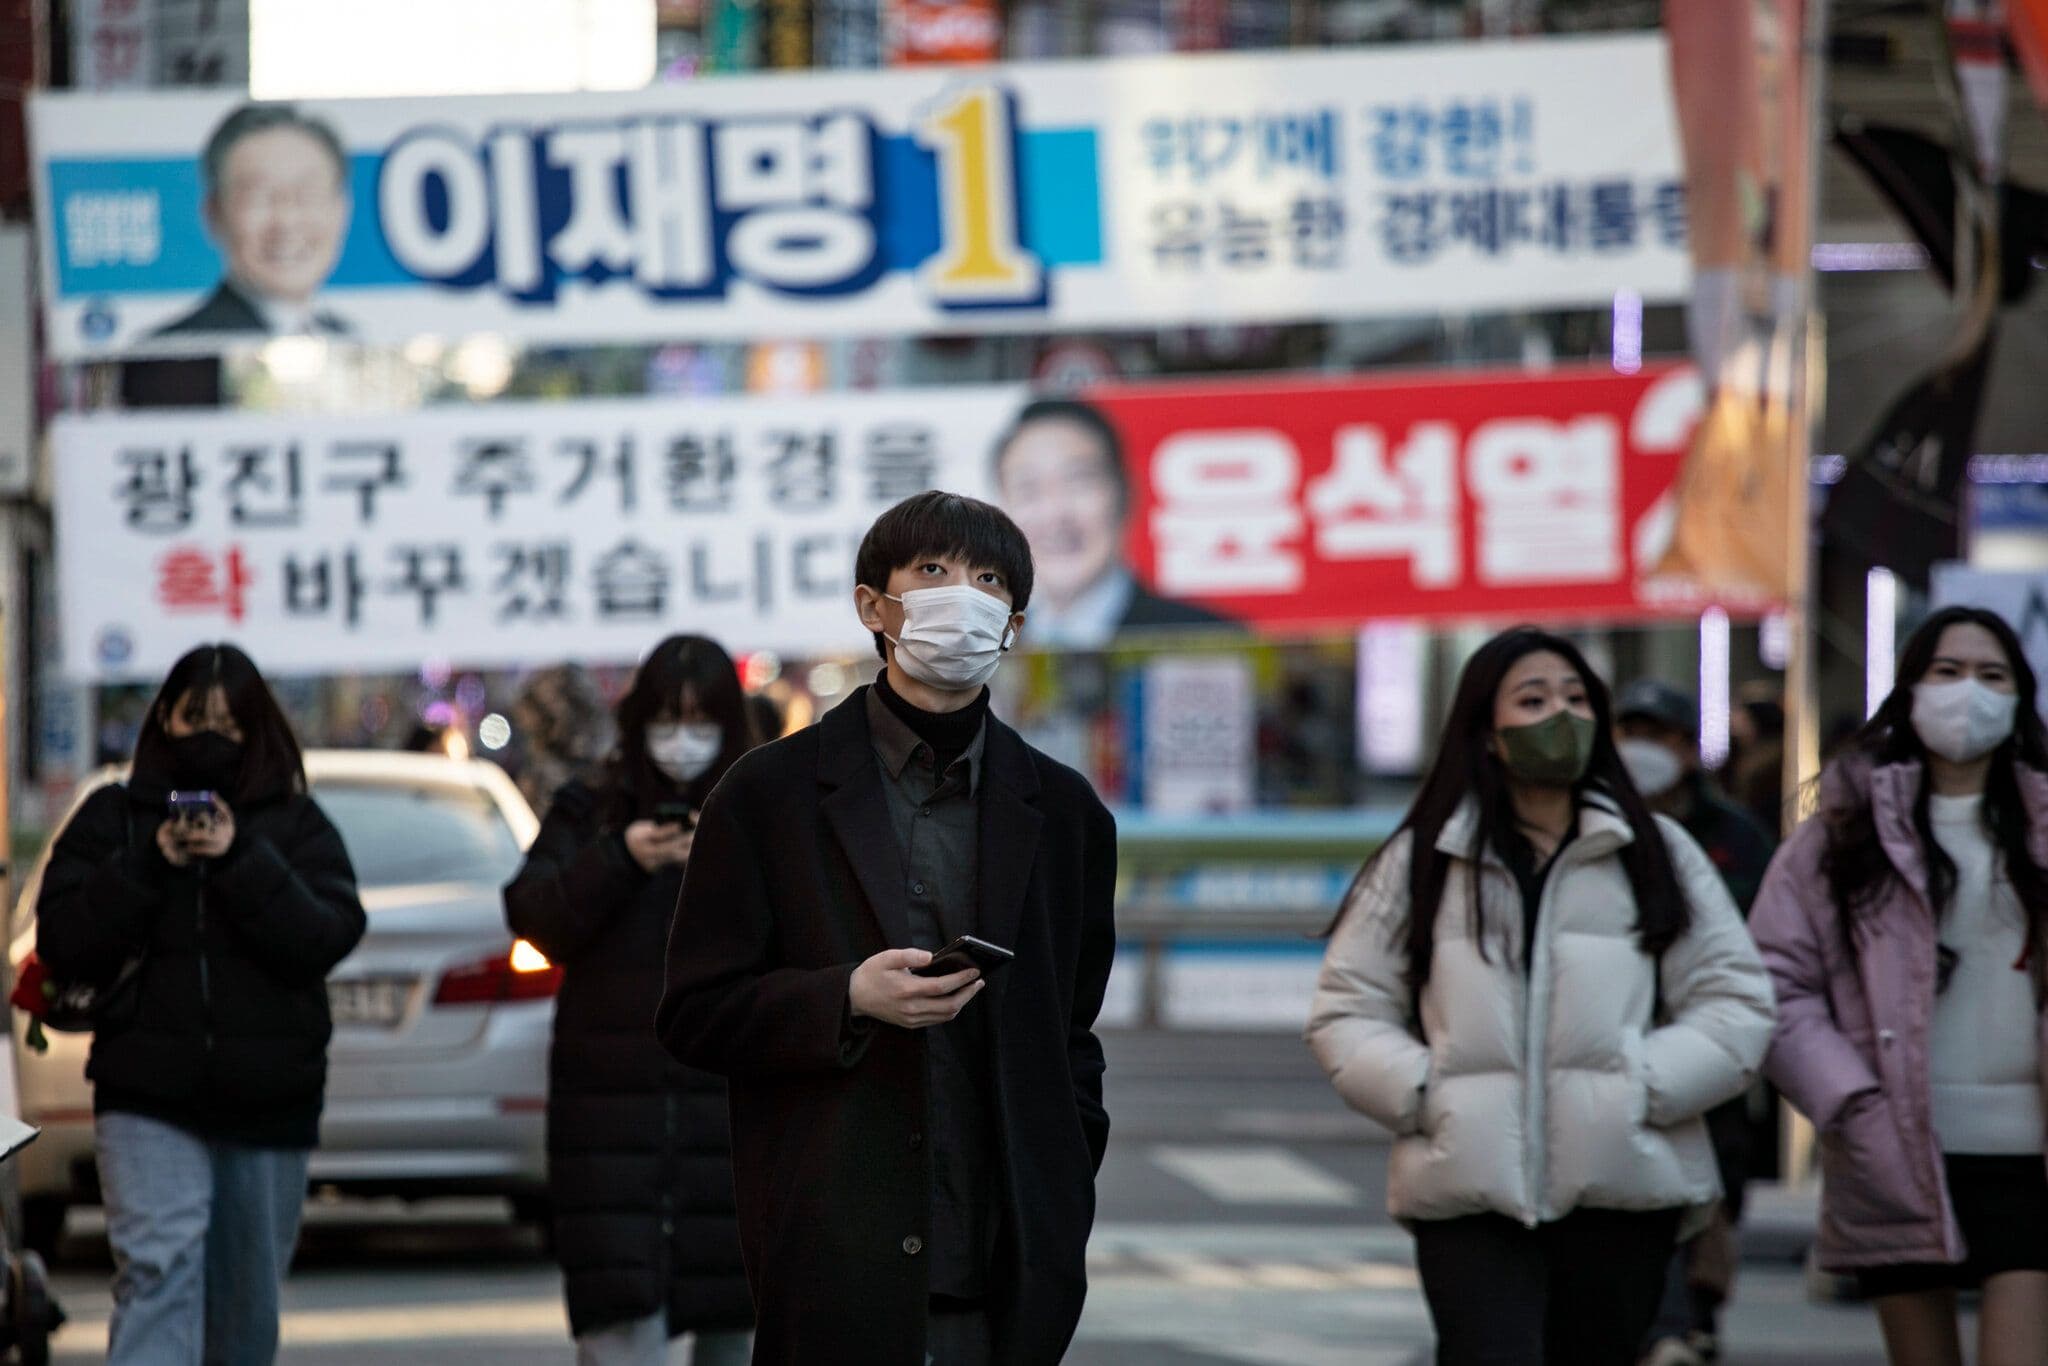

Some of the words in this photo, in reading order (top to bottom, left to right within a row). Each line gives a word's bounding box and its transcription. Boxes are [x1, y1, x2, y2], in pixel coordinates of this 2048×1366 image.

[1372, 98, 1534, 178] 강한!
[379, 114, 880, 292] 이재명
[918, 82, 1047, 313] 1
[1149, 199, 1348, 270] 유능한
[112, 442, 412, 532] 광진구
[455, 425, 938, 517] 주거환경을
[1150, 413, 1622, 596] 윤석열
